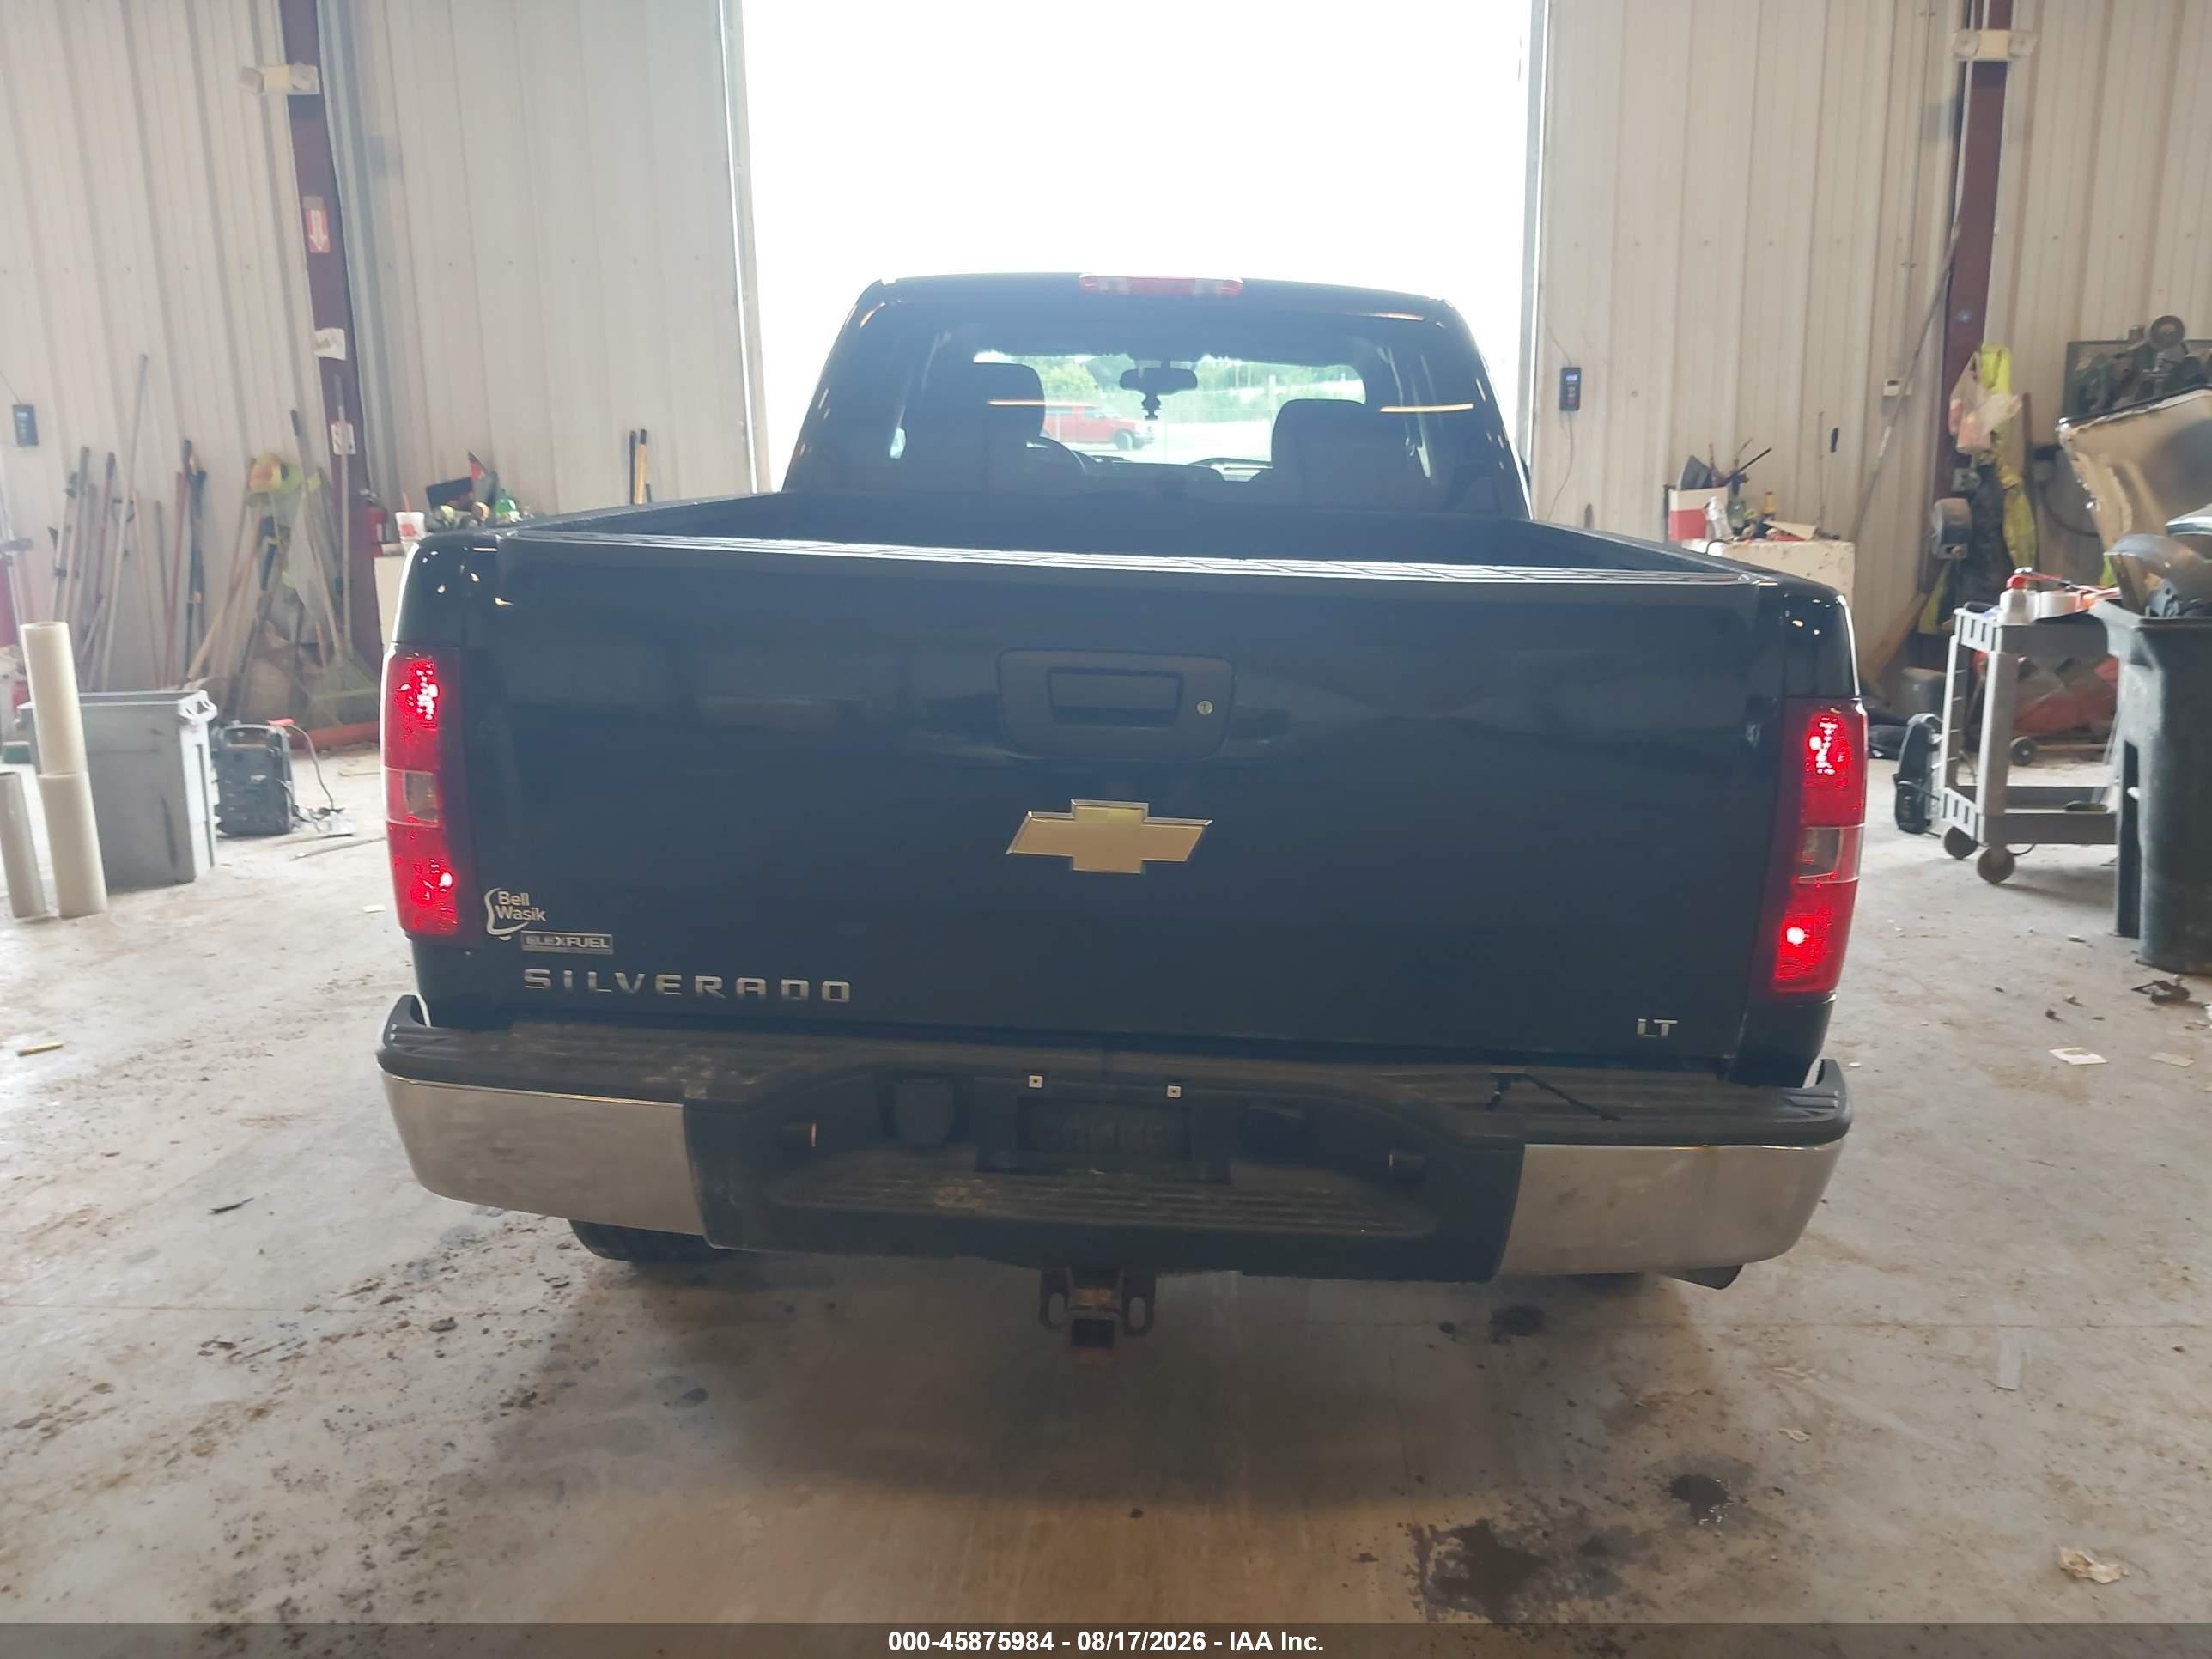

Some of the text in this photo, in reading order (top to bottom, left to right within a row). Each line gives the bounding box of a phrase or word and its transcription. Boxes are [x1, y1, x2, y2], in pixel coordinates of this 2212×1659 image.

[497, 890, 530, 906] Bell
[495, 904, 546, 921] Wasik
[523, 968, 851, 1004] SILVERADO
[1637, 1018, 1678, 1038] LT
